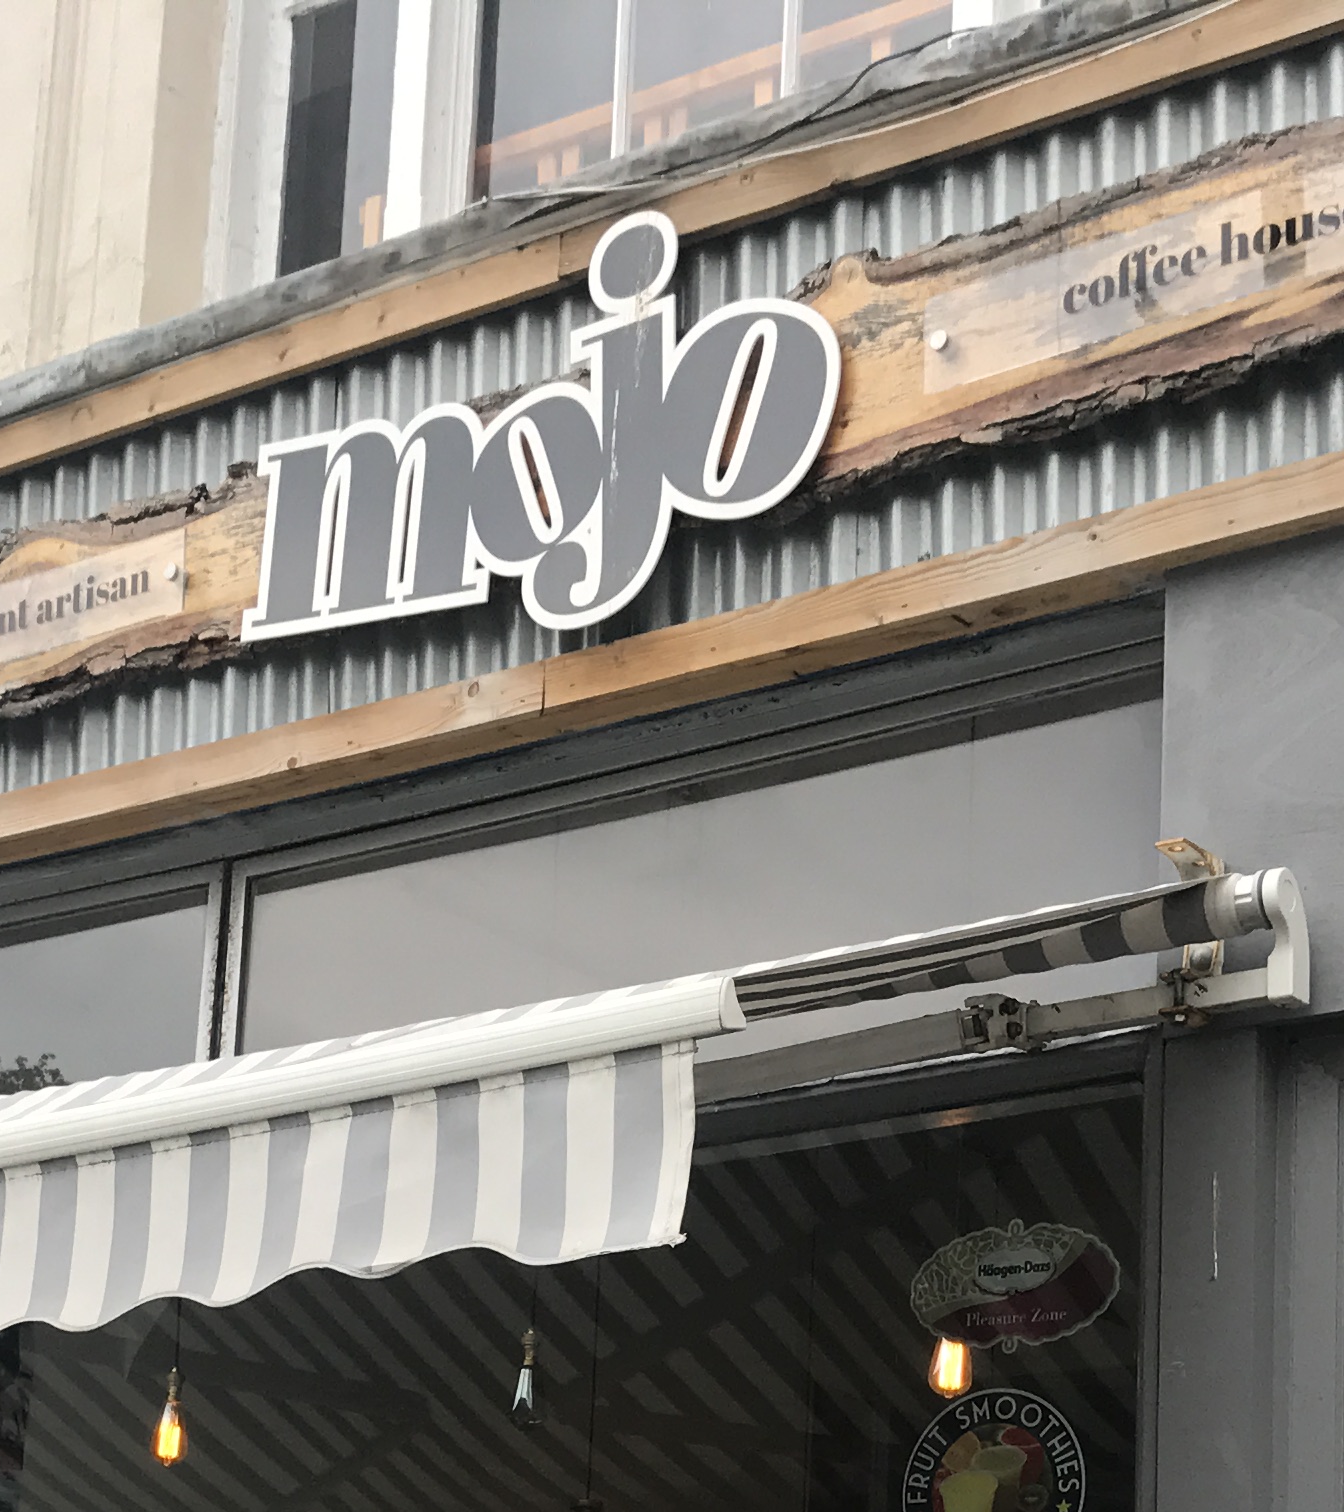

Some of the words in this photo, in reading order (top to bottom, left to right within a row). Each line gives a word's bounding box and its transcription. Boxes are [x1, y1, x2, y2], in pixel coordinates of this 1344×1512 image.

[1062, 243, 1207, 314] coffee
[240, 209, 843, 644] mojo
[36, 565, 151, 625] artisan
[965, 1308, 1027, 1328] Pleasure
[1030, 1305, 1068, 1323] Zone
[907, 1425, 950, 1506] FRUIT
[954, 1395, 1081, 1495] SMOOTHIES
